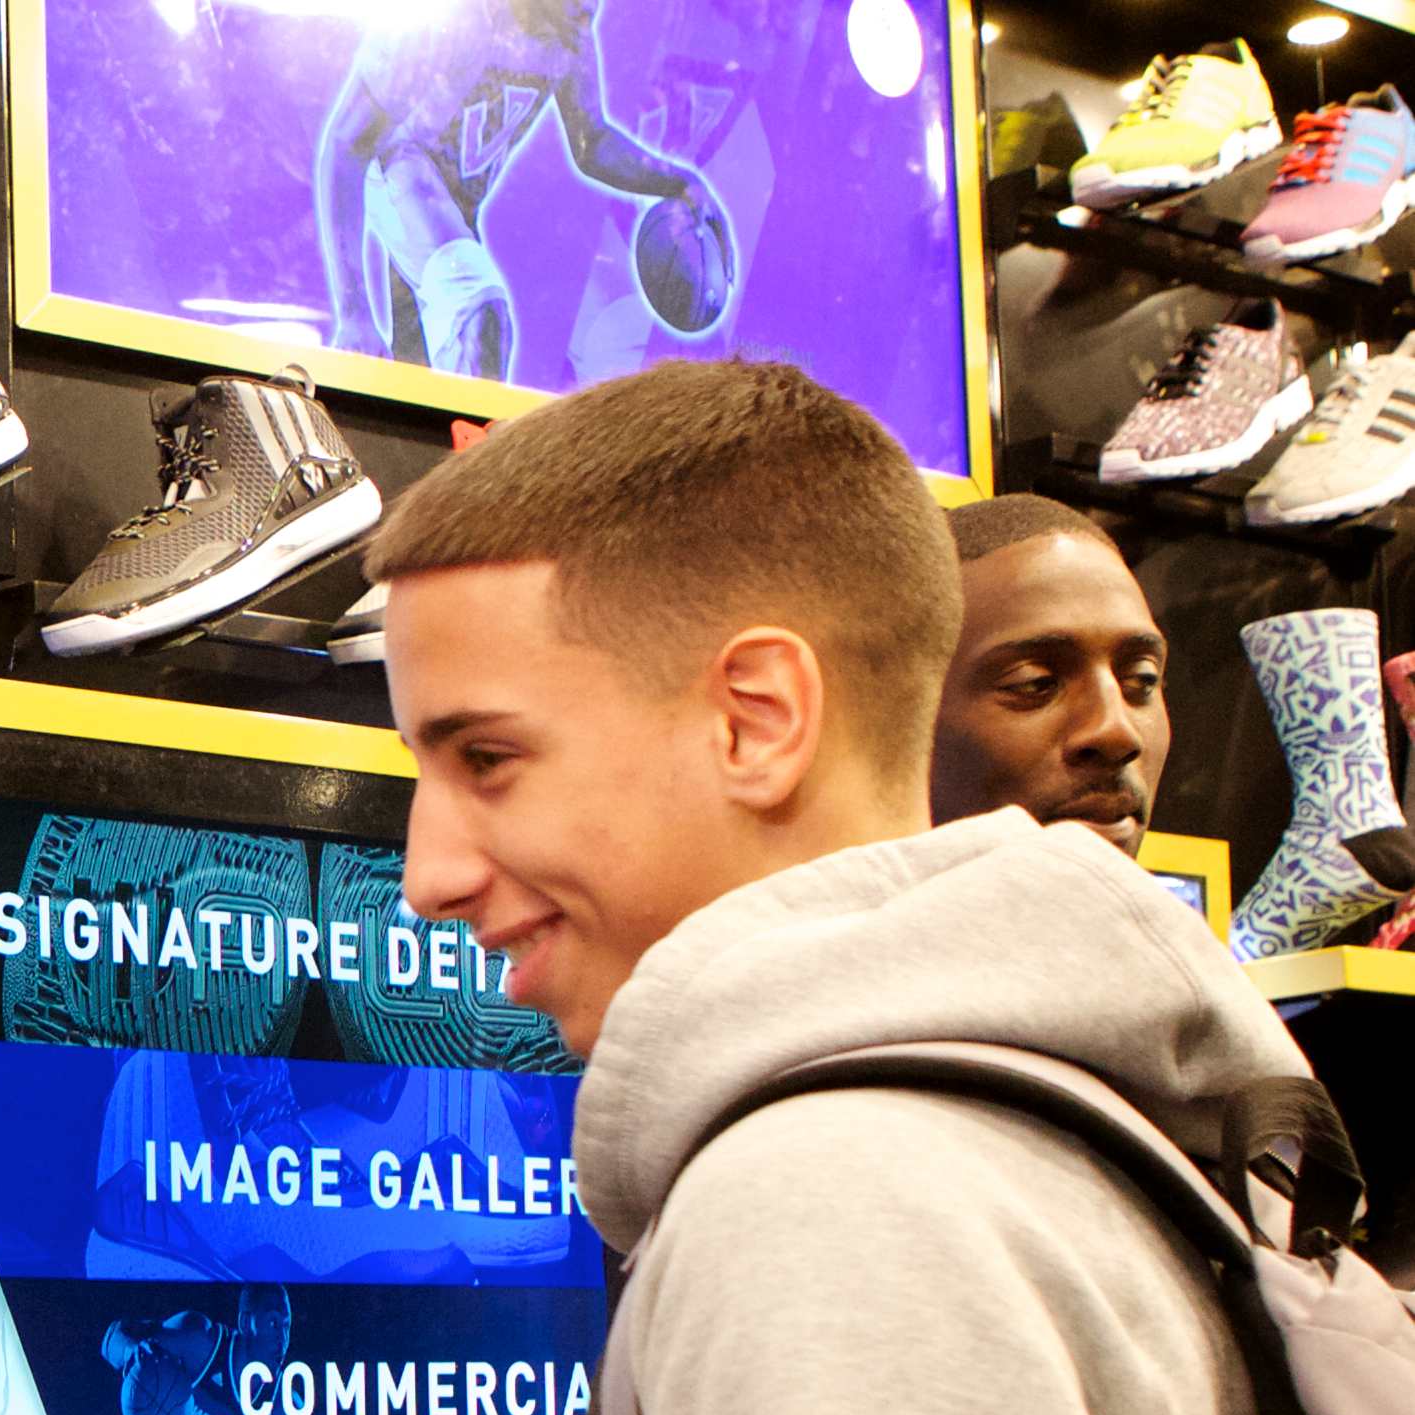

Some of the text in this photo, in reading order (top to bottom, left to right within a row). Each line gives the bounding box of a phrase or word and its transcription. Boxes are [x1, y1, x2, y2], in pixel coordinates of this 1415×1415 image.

[387, 926, 511, 993] DET
[145, 1141, 589, 1215] IMAGE GALLER
